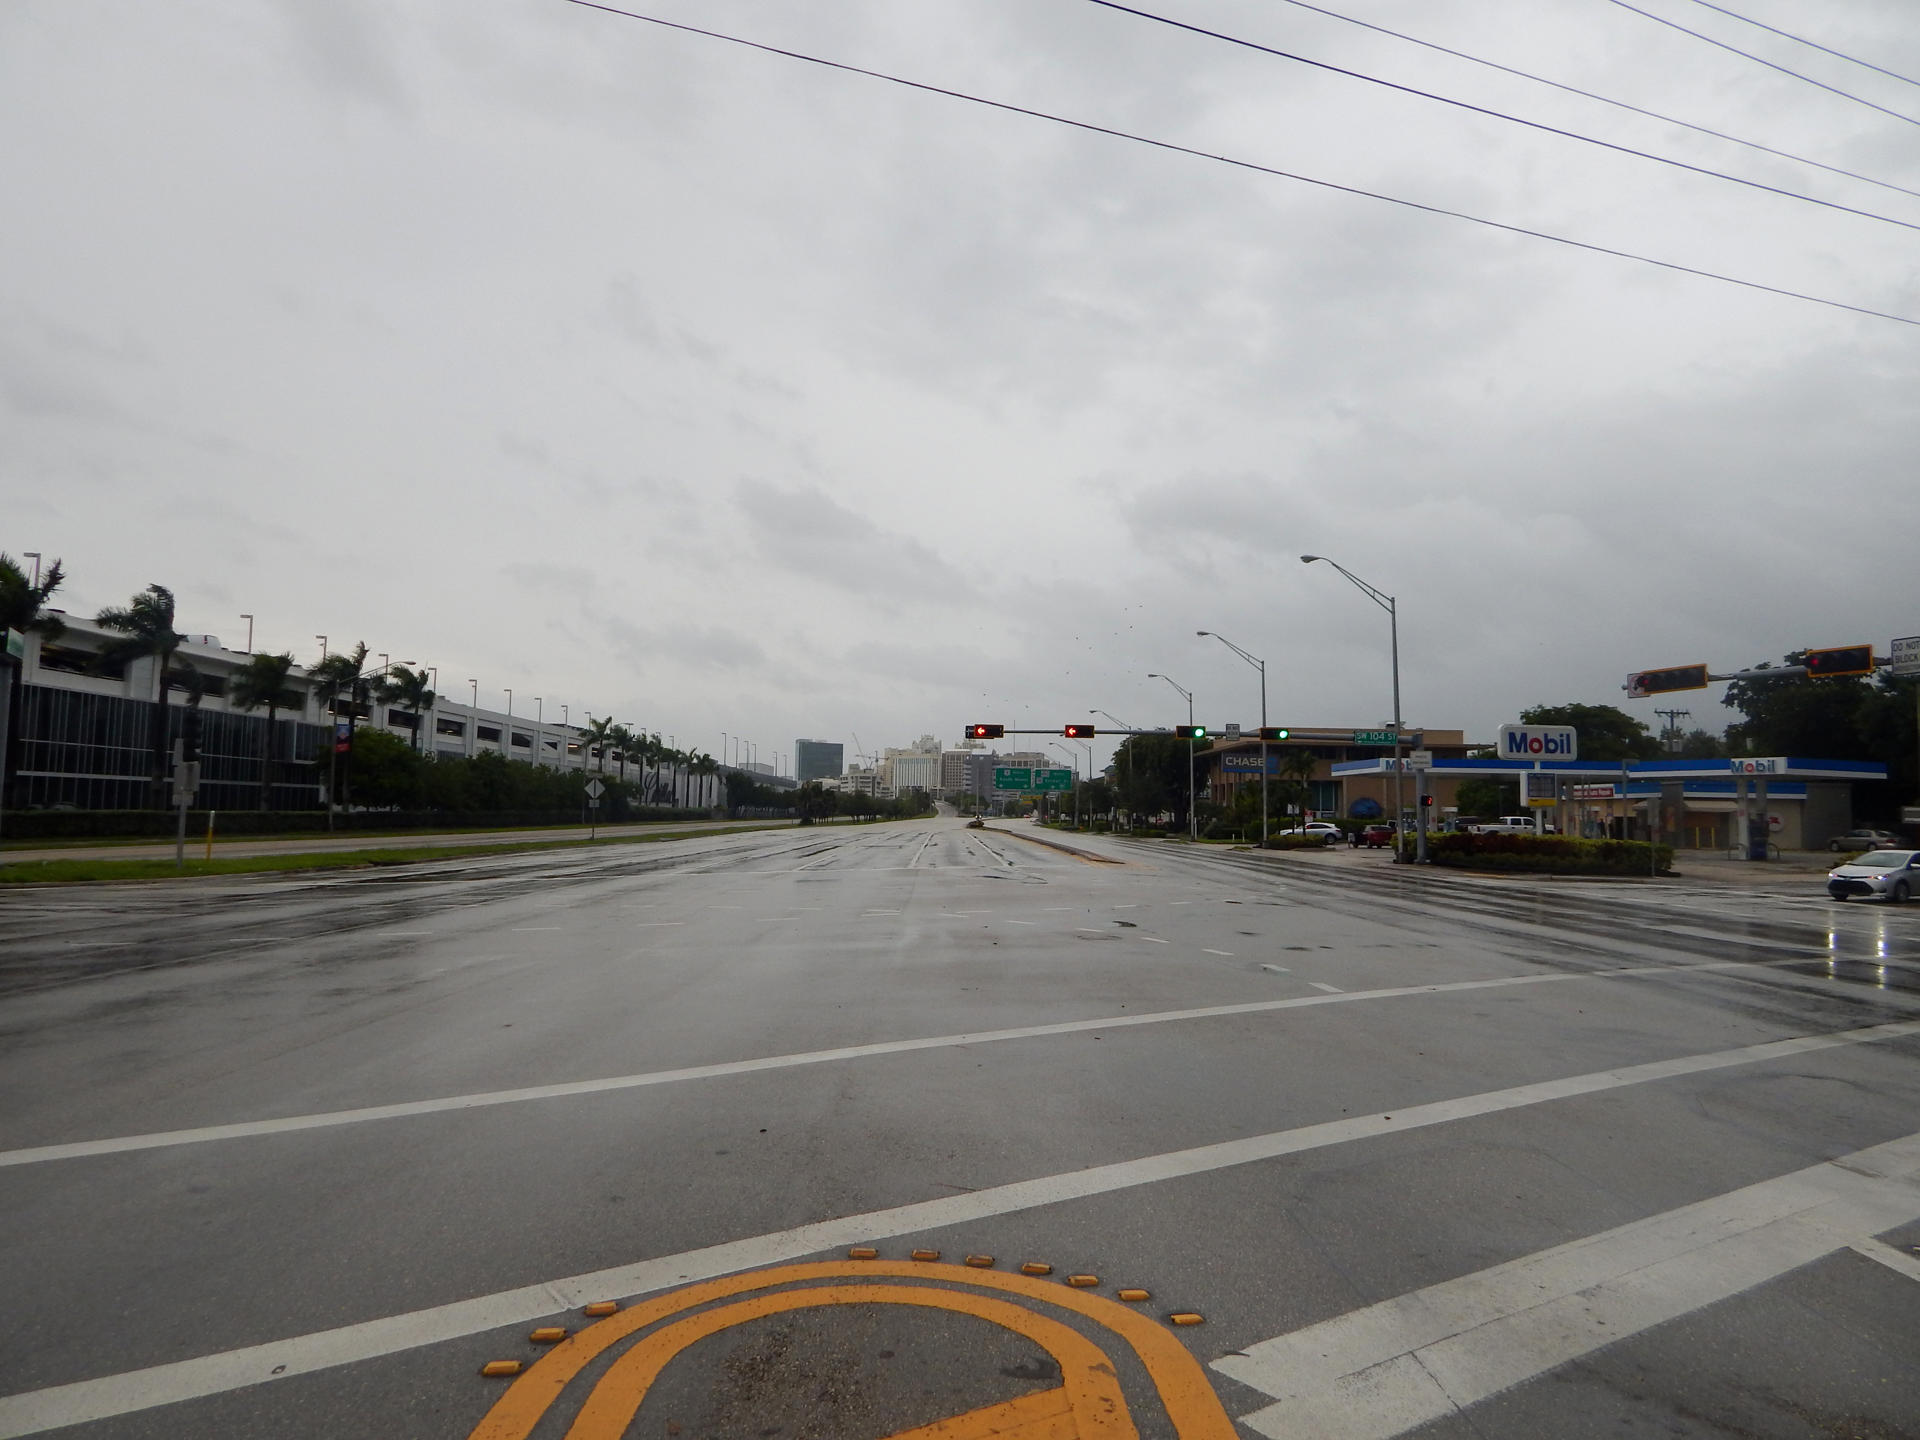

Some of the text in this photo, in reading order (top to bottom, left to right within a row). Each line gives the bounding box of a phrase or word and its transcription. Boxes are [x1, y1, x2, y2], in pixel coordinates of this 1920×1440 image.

[1893, 643, 1903, 652] DO
[1357, 732, 1397, 741] SW 104 ST
[1508, 731, 1571, 754] Mobil
[1225, 756, 1264, 767] CHASE
[1730, 759, 1775, 774] Mobil
